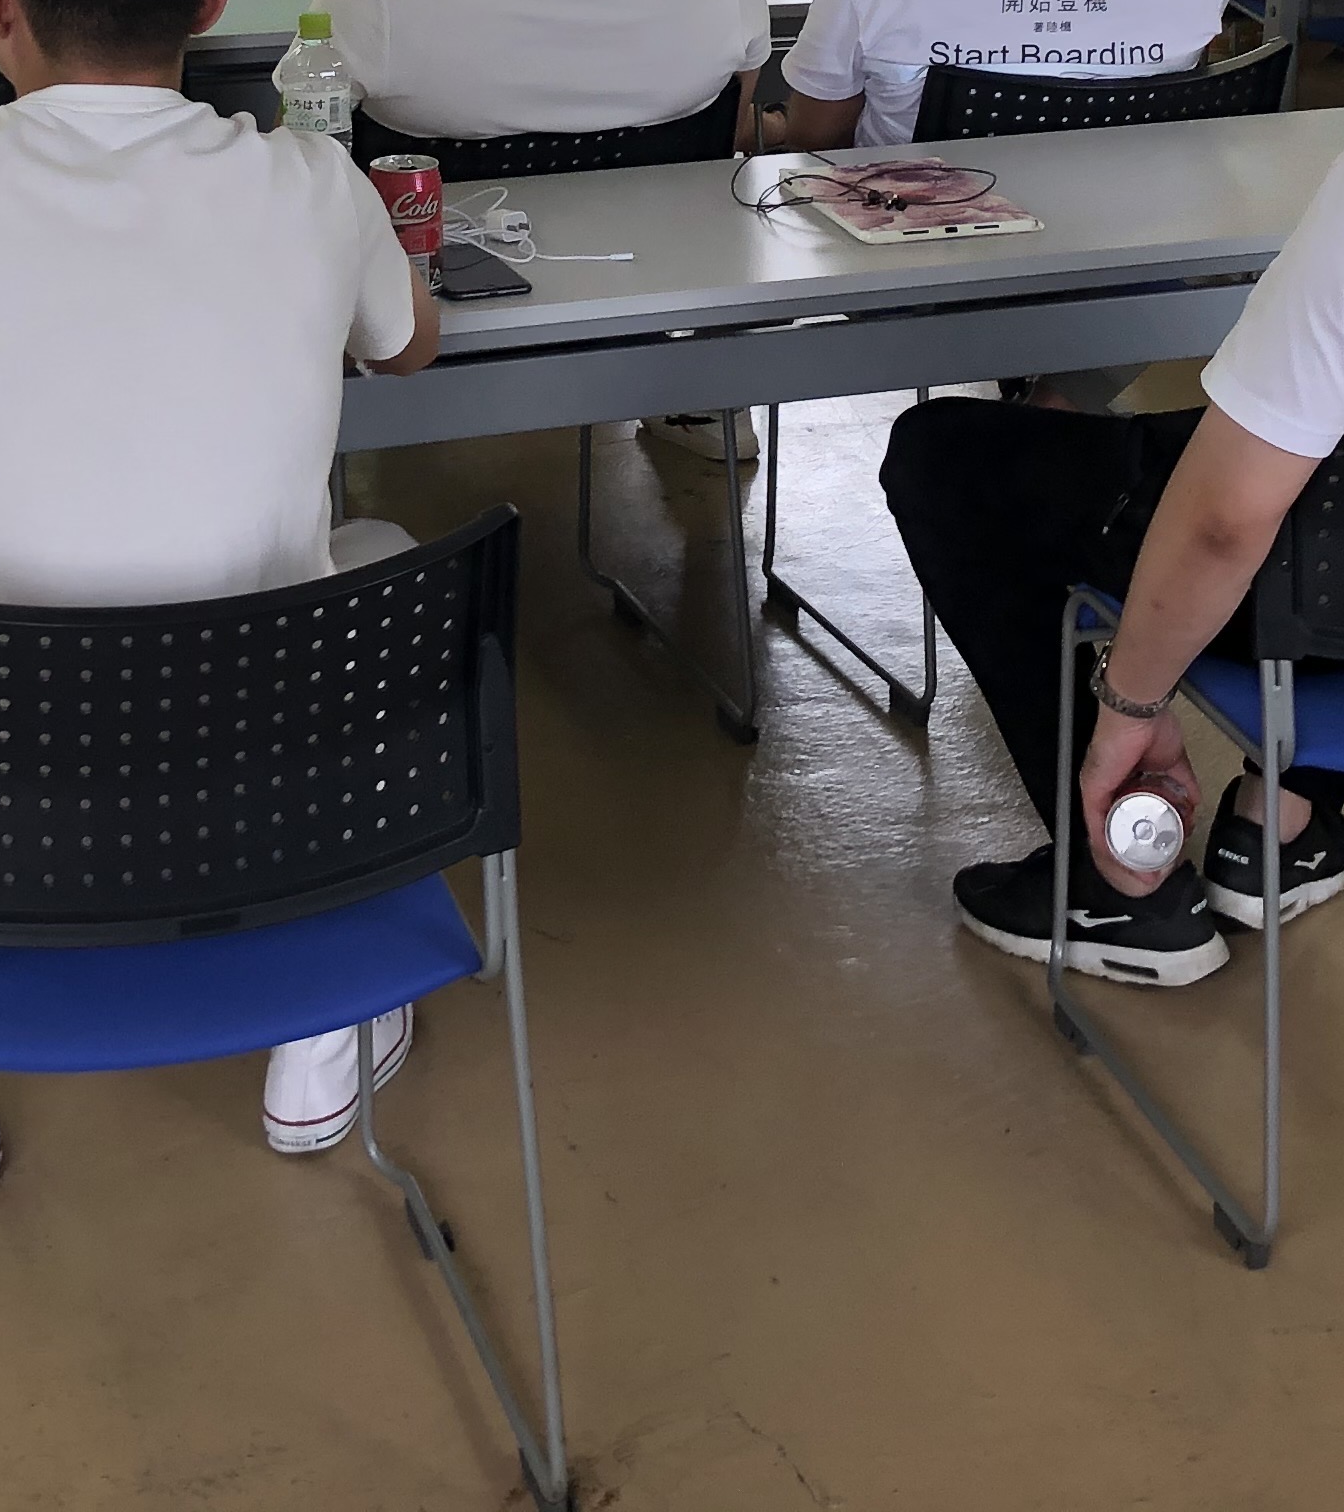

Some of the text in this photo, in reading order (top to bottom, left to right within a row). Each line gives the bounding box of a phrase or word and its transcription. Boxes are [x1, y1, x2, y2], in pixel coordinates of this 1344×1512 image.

[928, 41, 1165, 66] Start Boarding
[391, 191, 439, 223] Cola
